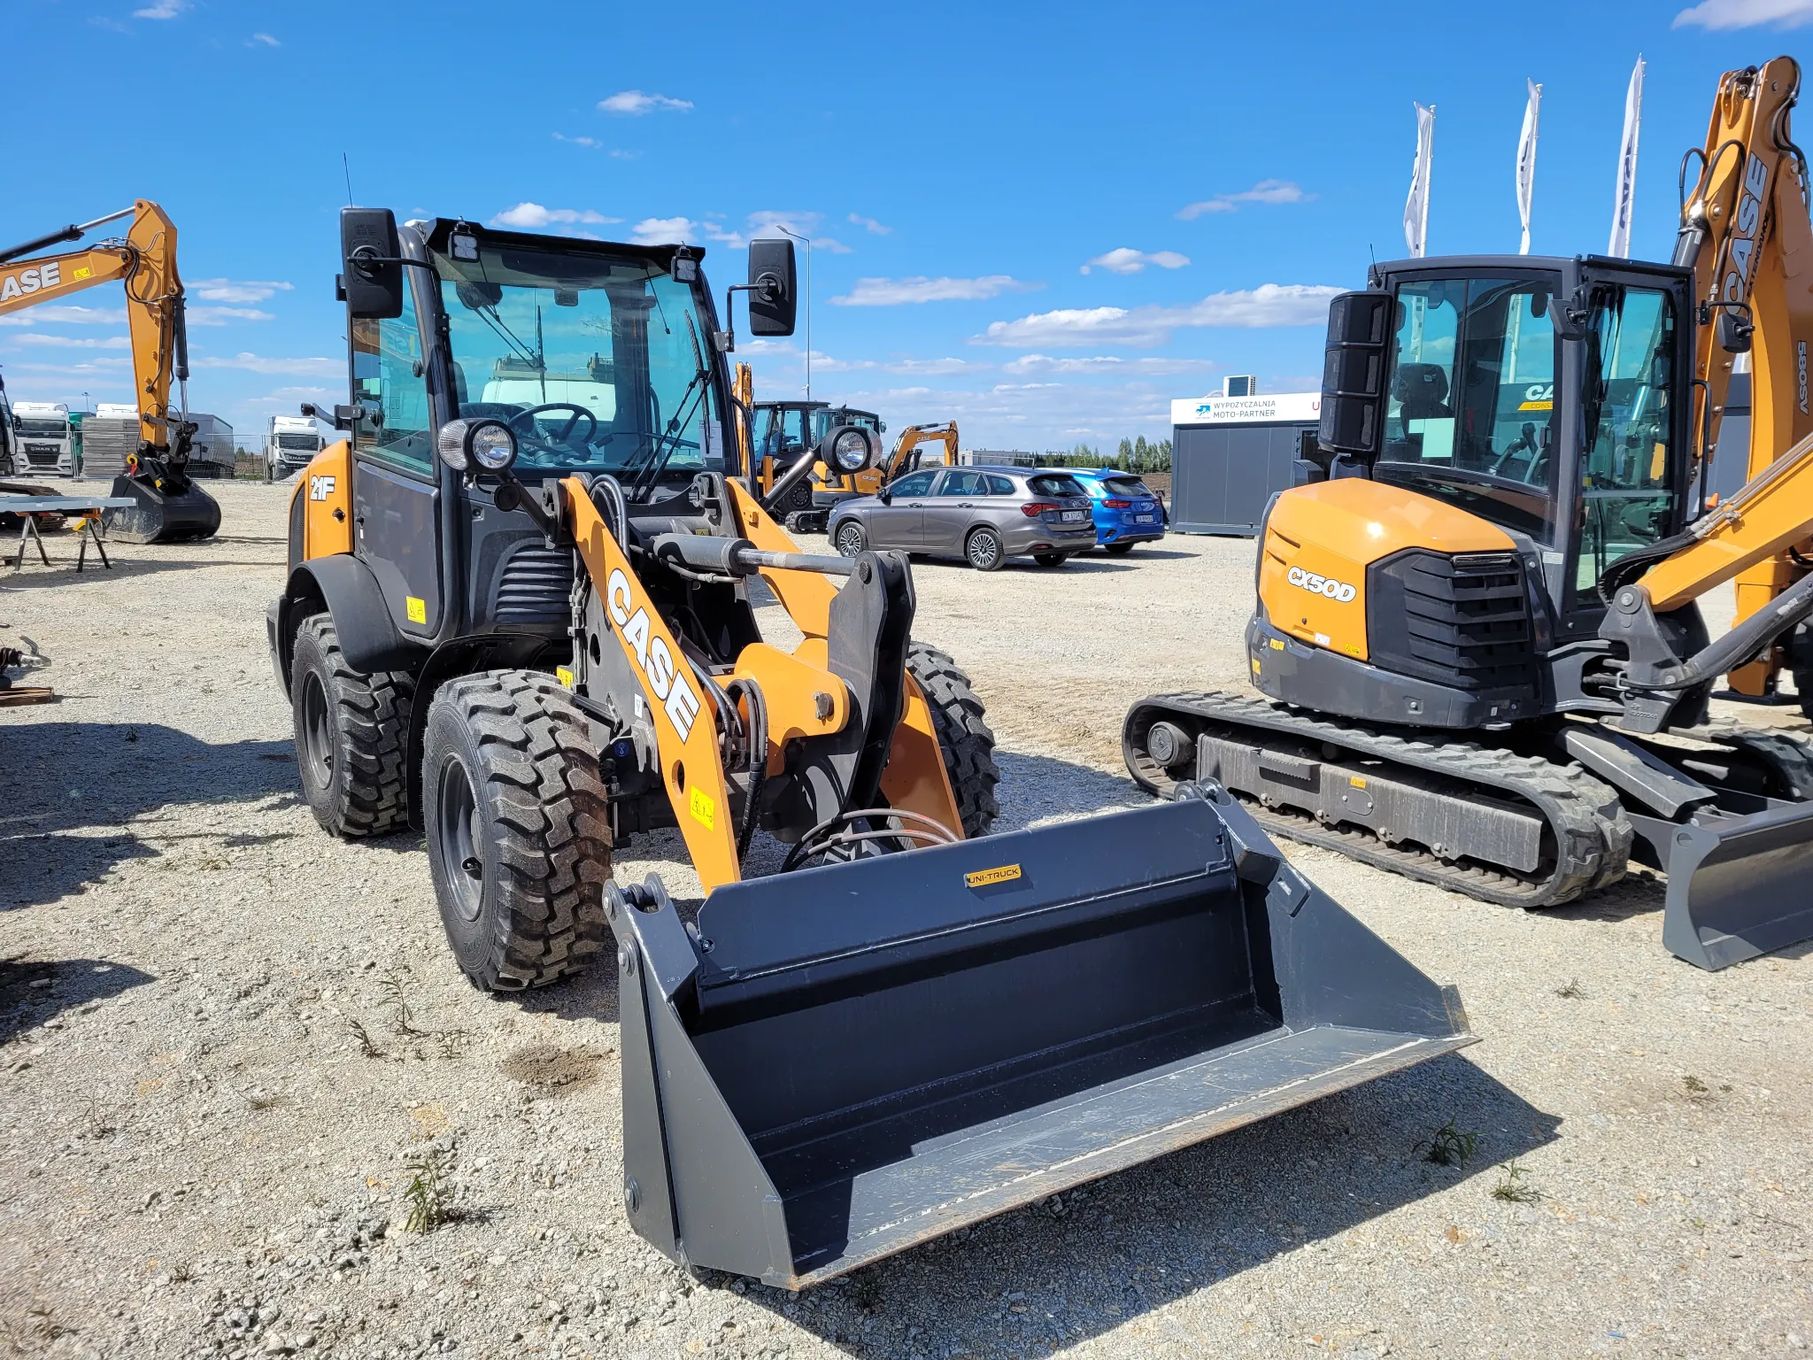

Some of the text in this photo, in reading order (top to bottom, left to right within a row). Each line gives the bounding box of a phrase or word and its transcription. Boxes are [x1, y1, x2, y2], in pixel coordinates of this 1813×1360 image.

[1724, 151, 1768, 315] CASE
[0, 261, 60, 301] ASE
[1213, 409, 1276, 419] MOTO-PARTNER
[311, 475, 336, 501] 21F
[1287, 566, 1356, 602] CX50D
[607, 568, 701, 745] CASE
[968, 868, 1020, 884] UNI-TRUCK
